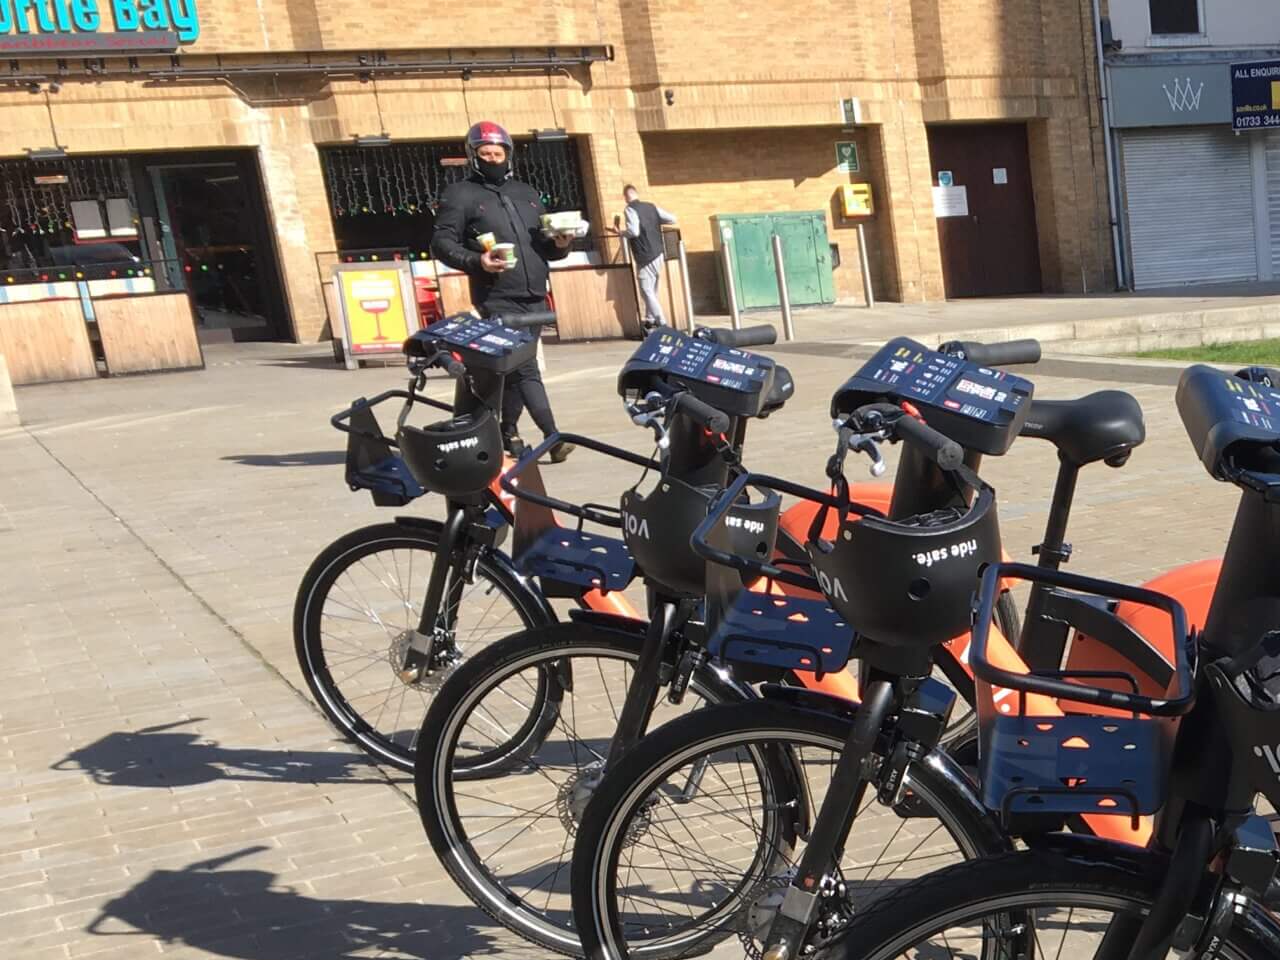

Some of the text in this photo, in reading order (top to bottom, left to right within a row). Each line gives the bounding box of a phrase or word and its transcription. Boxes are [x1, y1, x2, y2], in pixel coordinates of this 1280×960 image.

[115, 0, 200, 42] Bay
[1234, 69, 1249, 78] ALL
[1236, 116, 1261, 127] 01733
[743, 519, 765, 534] ride
[911, 538, 978, 568] ride safe.
